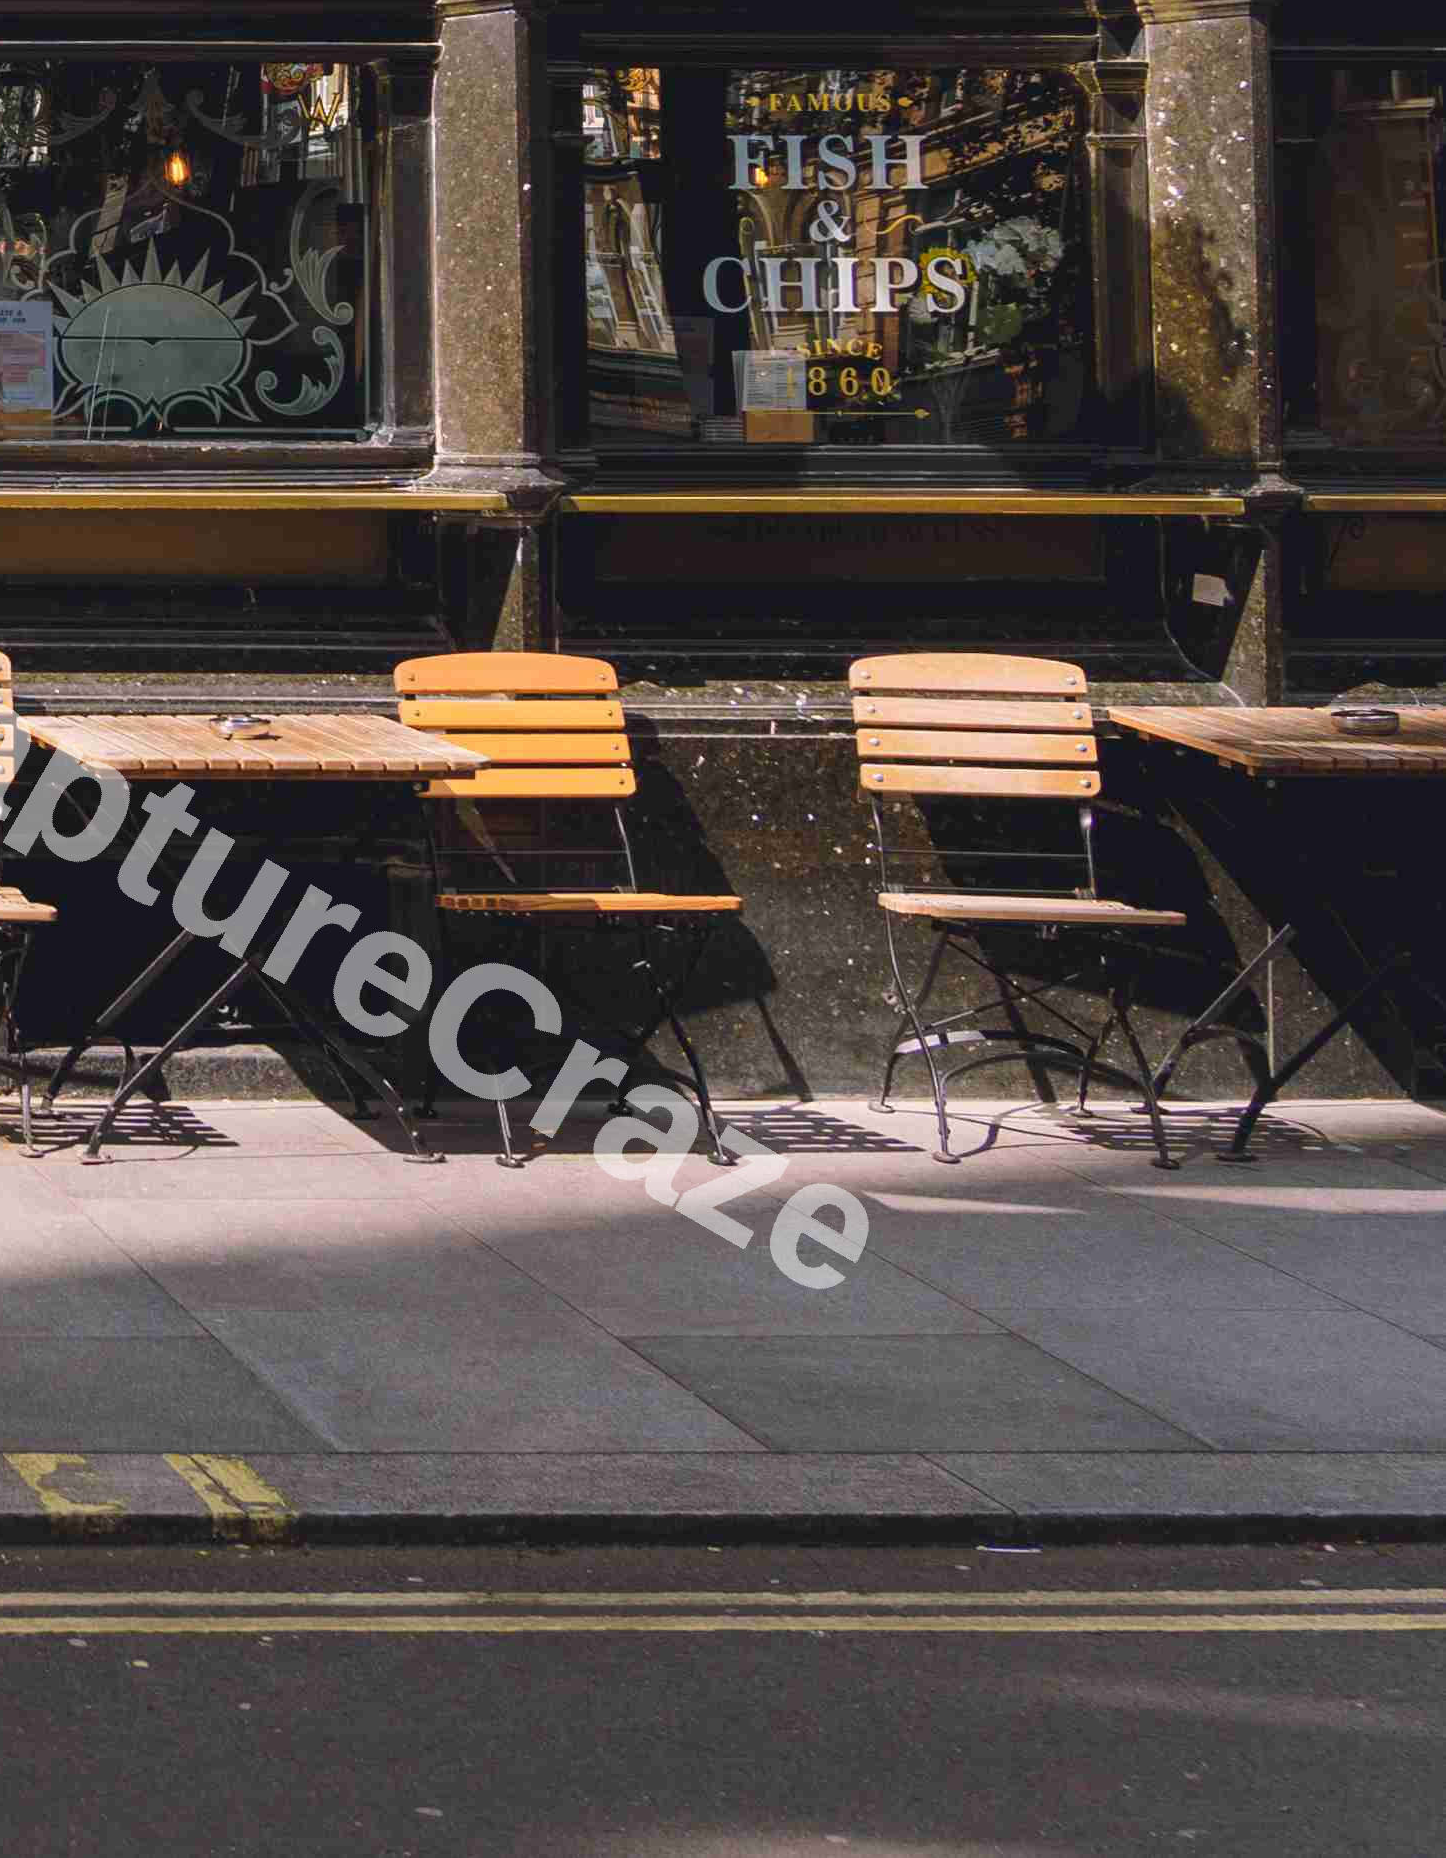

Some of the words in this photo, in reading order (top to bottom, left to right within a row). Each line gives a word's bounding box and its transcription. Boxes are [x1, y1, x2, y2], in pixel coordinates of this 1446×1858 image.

[769, 93, 892, 112] FAMOUS
[727, 134, 930, 191] FISH
[809, 199, 853, 242] &
[703, 255, 969, 314] CHIPS
[795, 337, 884, 360] SINCE
[787, 366, 892, 399] 1860
